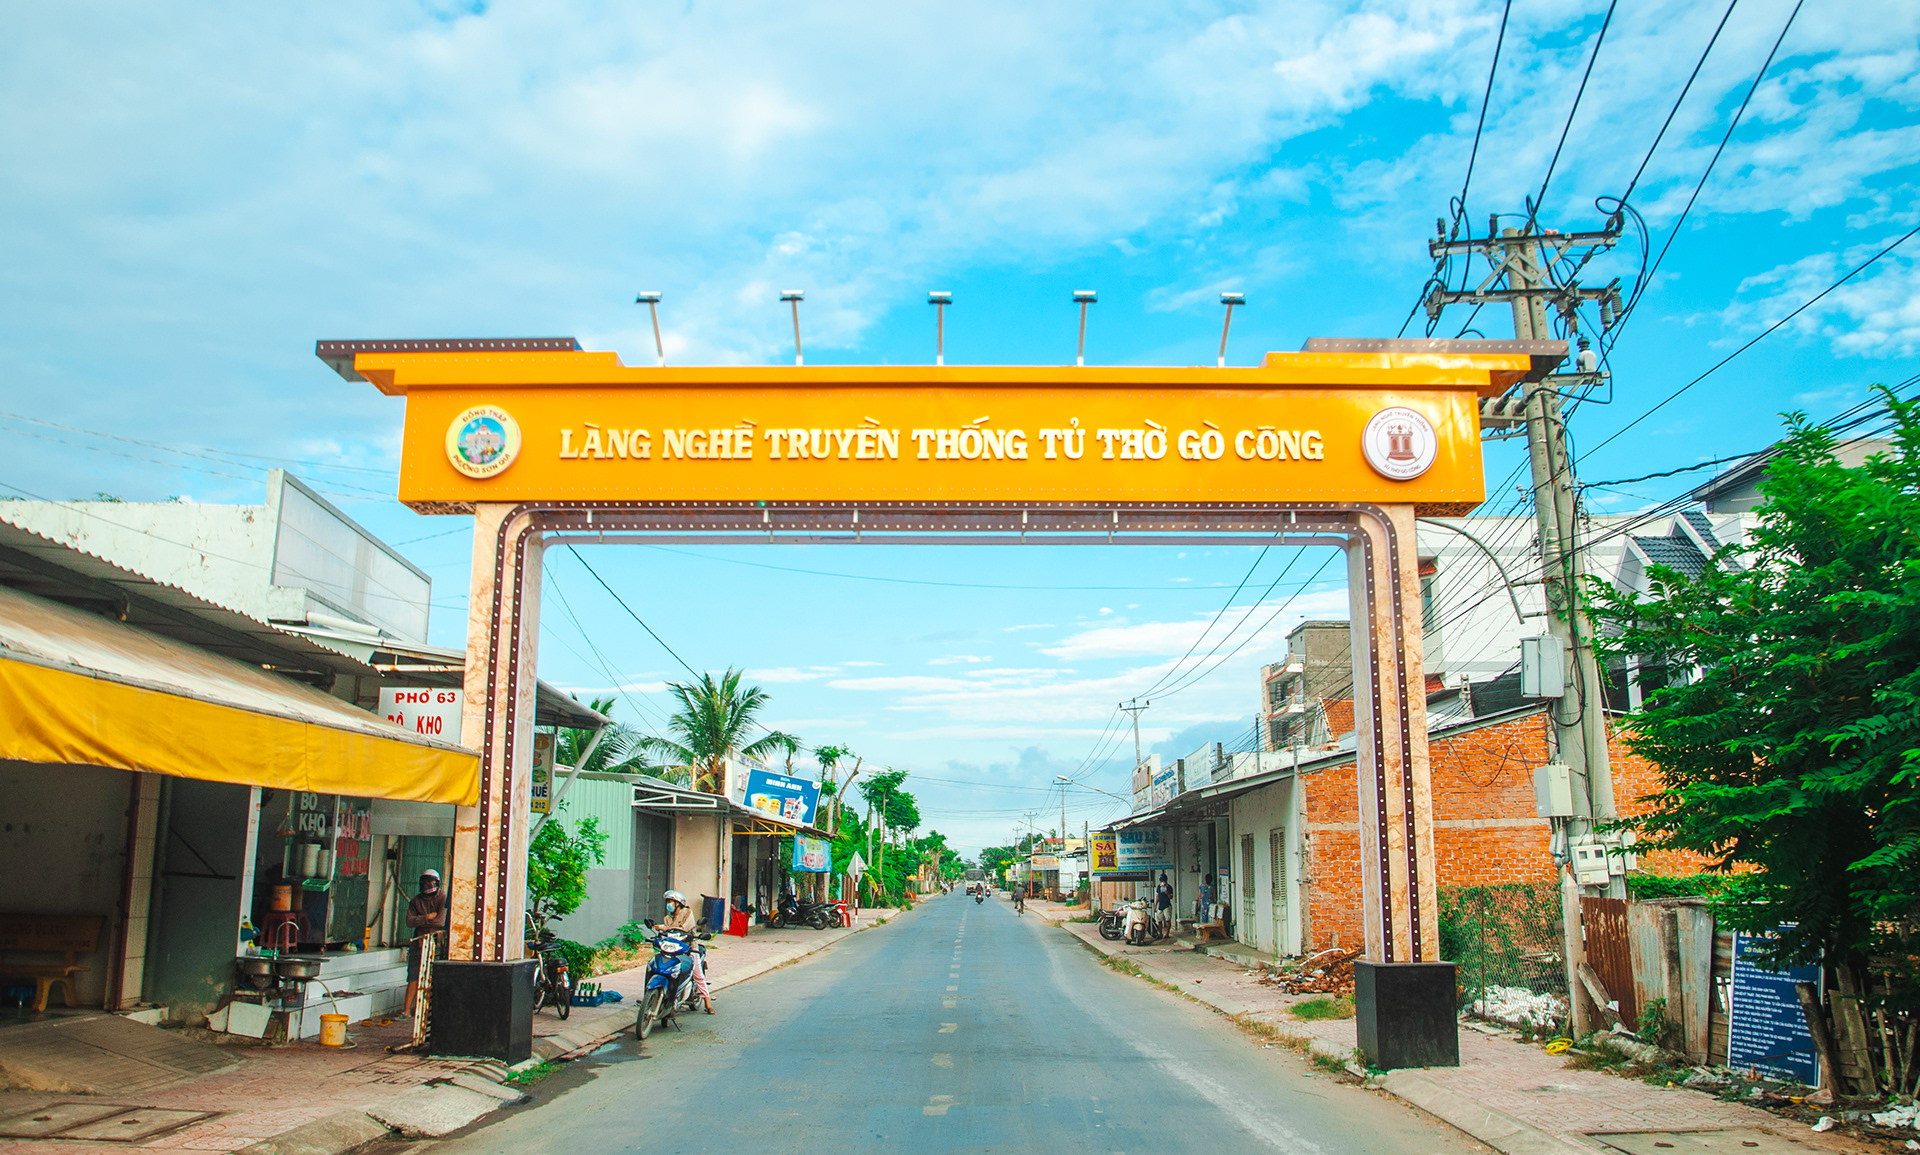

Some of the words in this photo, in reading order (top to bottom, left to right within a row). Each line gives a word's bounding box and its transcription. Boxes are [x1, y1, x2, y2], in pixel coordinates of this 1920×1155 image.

[559, 421, 652, 460] LÀNG
[661, 417, 757, 460] NGHỀ
[764, 415, 900, 460] TRUYỀN
[911, 415, 1029, 460] THỐNG
[1038, 416, 1086, 460] TỦ
[1096, 418, 1168, 460] THỜ
[1177, 419, 1225, 460] GÒ
[1234, 425, 1325, 460] CÔNG
[395, 688, 433, 704] PHỞ
[436, 692, 456, 704] 63
[416, 715, 443, 735] KHO
[299, 813, 327, 832] KHO
